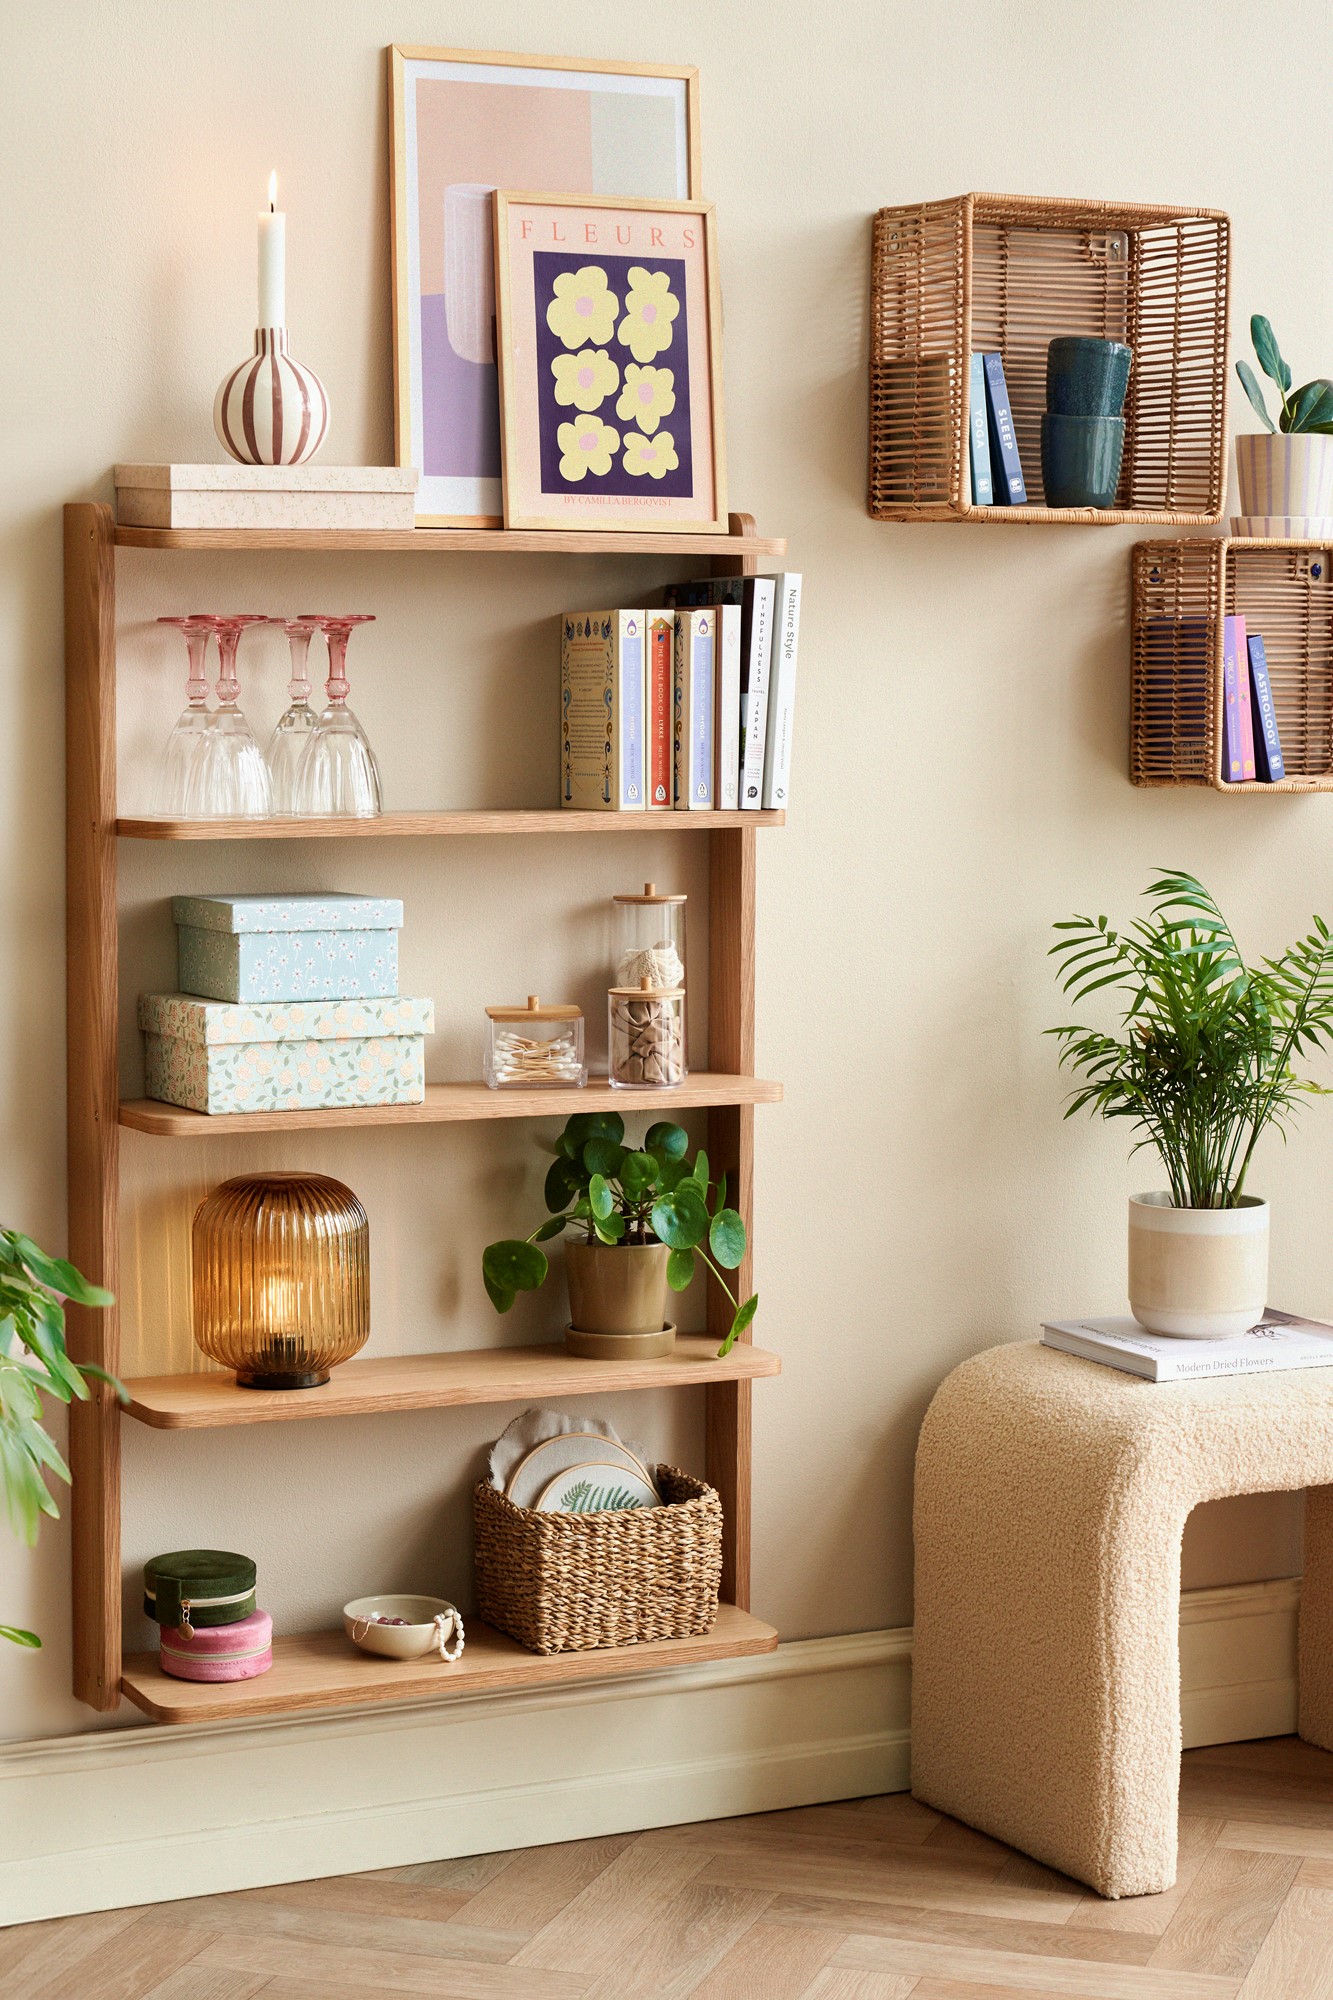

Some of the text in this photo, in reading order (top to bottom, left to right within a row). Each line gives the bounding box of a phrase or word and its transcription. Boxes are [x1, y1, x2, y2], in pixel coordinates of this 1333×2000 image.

[520, 219, 696, 249] FLEURS
[974, 409, 985, 449] YOGA
[998, 409, 1013, 449] SLEEP
[564, 495, 673, 507] BY CAMILLA BERGQVIST
[784, 589, 797, 659] Nature Style
[756, 596, 767, 683] MINDFULNESS
[1226, 655, 1235, 685] VIRGO
[629, 703, 636, 712] OF
[657, 705, 664, 716] OF
[700, 702, 706, 711] OF
[1257, 673, 1276, 745] ASTROLOGY
[628, 716, 636, 740] HYGGE
[1176, 1356, 1274, 1374] Modern Dried Flowers
